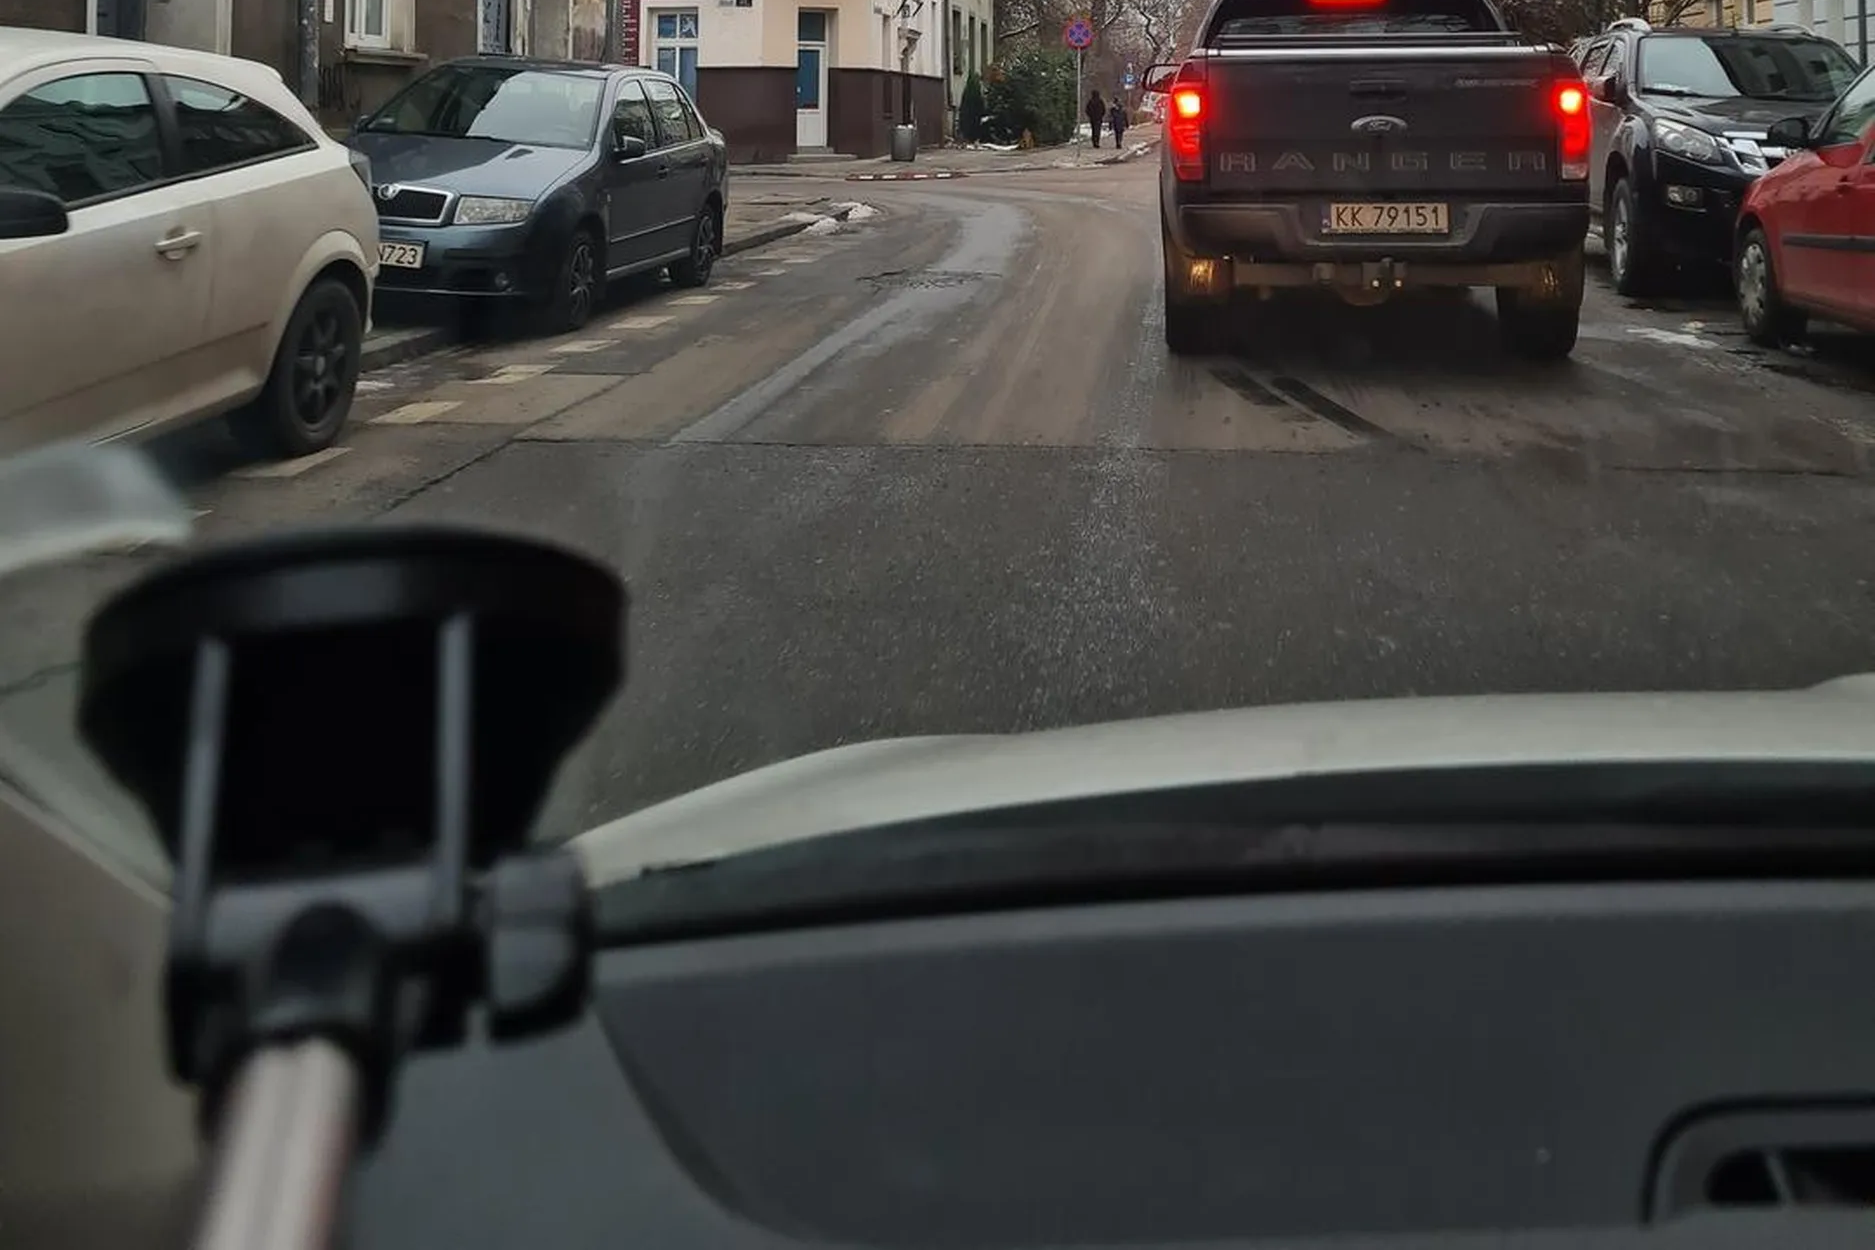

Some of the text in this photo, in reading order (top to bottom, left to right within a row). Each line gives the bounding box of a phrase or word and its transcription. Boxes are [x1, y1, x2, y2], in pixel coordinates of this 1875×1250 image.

[1219, 152, 1546, 172] RANGER
[1335, 206, 1363, 227] KK
[1373, 206, 1439, 227] 79151
